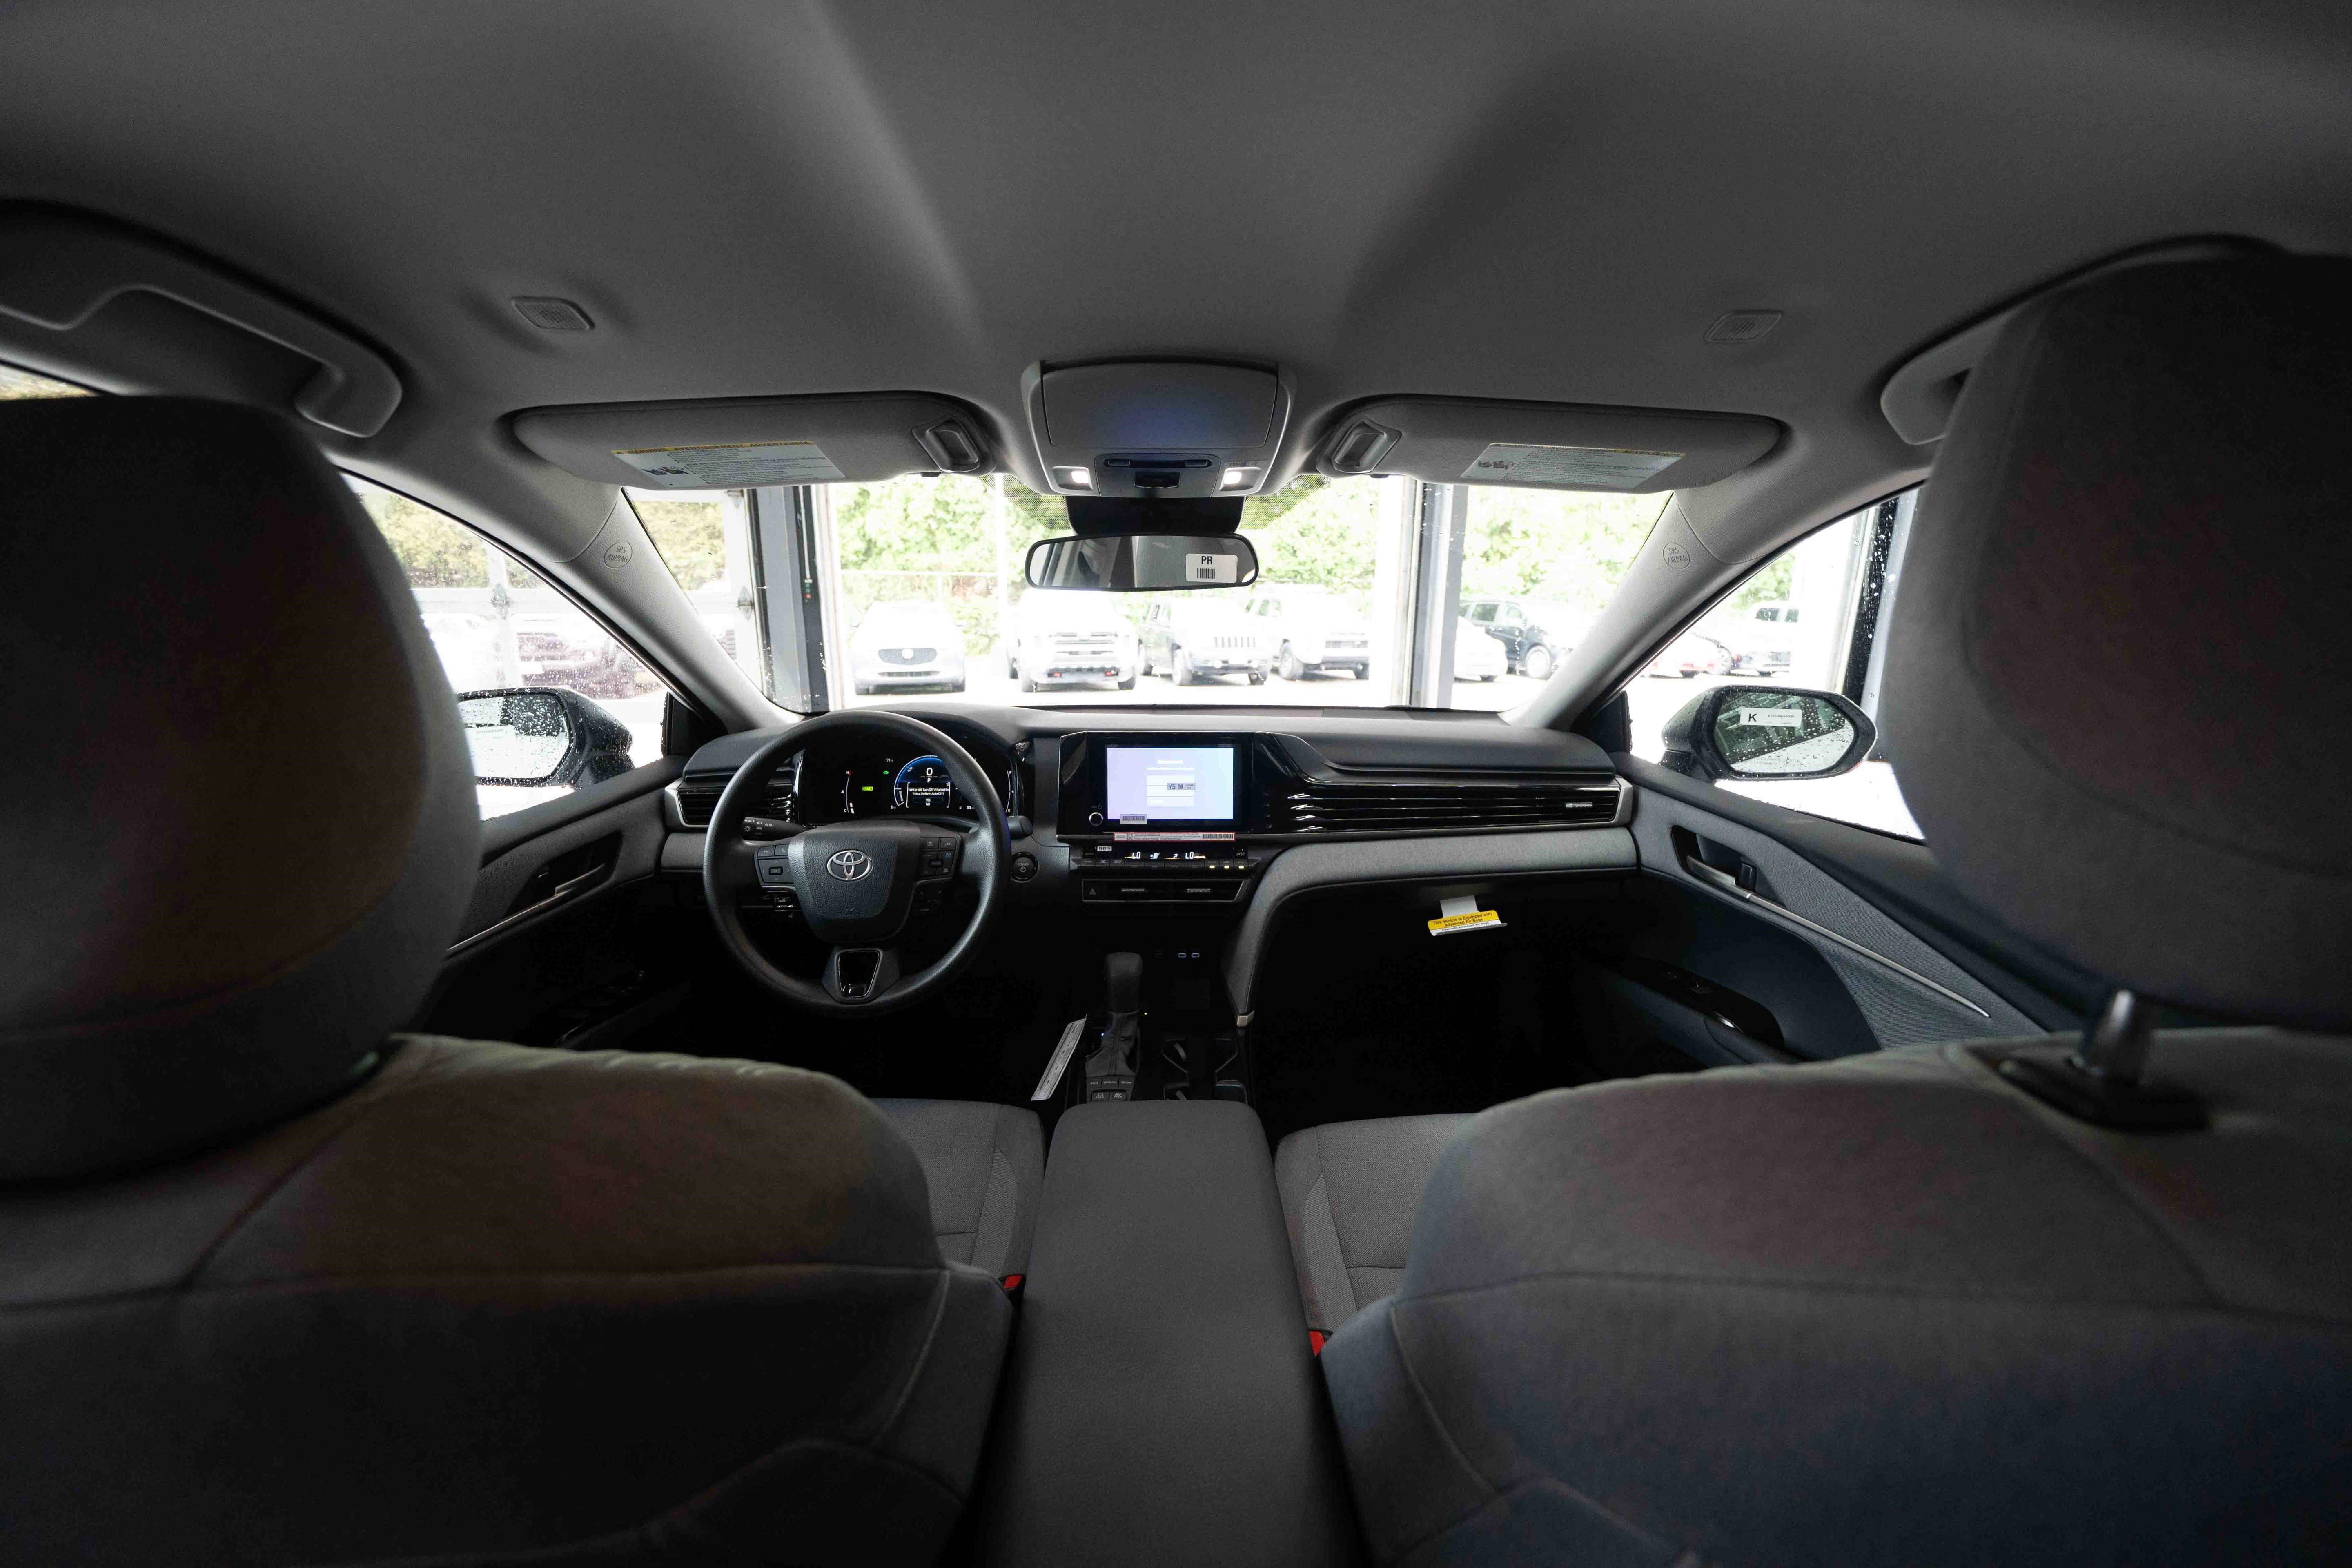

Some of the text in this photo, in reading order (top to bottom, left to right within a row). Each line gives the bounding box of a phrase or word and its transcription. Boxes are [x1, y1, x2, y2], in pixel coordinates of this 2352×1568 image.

[606, 554, 628, 562] AIRBAG
[1201, 556, 1212, 564] PR
[1668, 555, 1688, 564] AIRBAG
[1748, 713, 1757, 722] K
